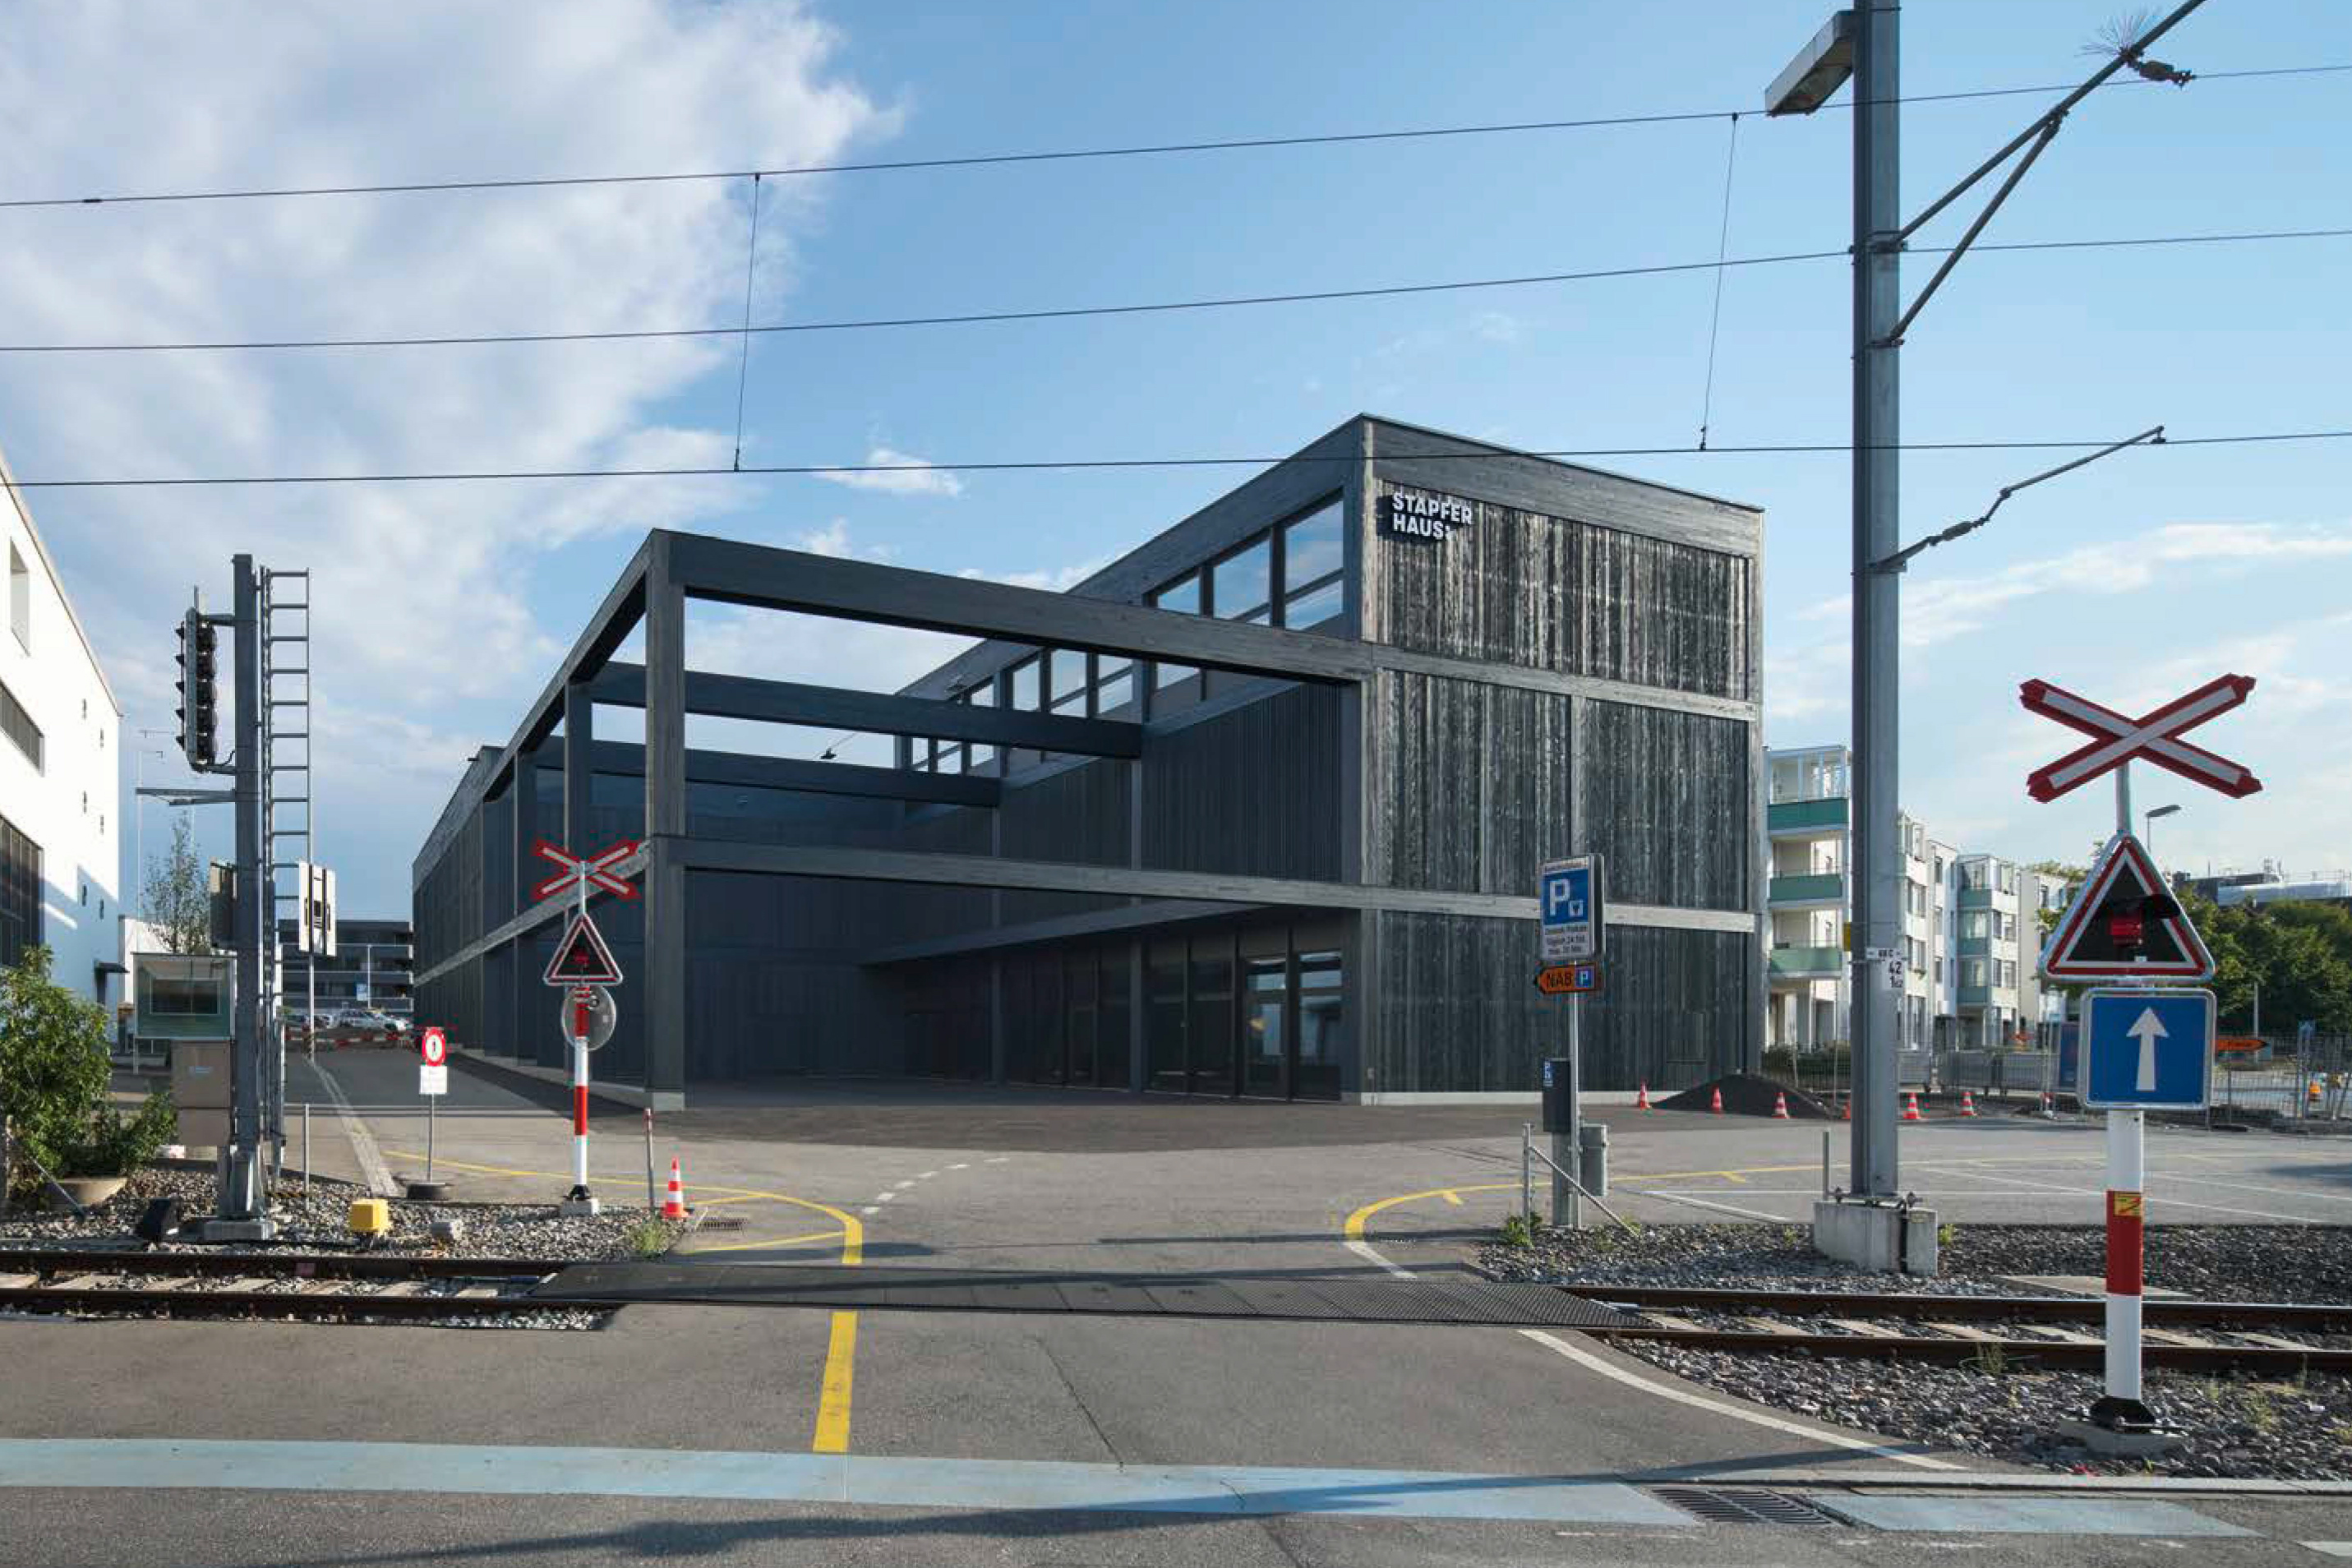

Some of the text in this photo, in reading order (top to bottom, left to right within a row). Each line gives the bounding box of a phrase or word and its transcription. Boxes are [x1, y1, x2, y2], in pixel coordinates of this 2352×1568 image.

[1393, 492, 1472, 524] STAPFER
[1393, 513, 1444, 540] HAUS
[1550, 879, 1570, 916] P
[1580, 971, 1589, 985] P
[1889, 961, 1902, 975] 42
